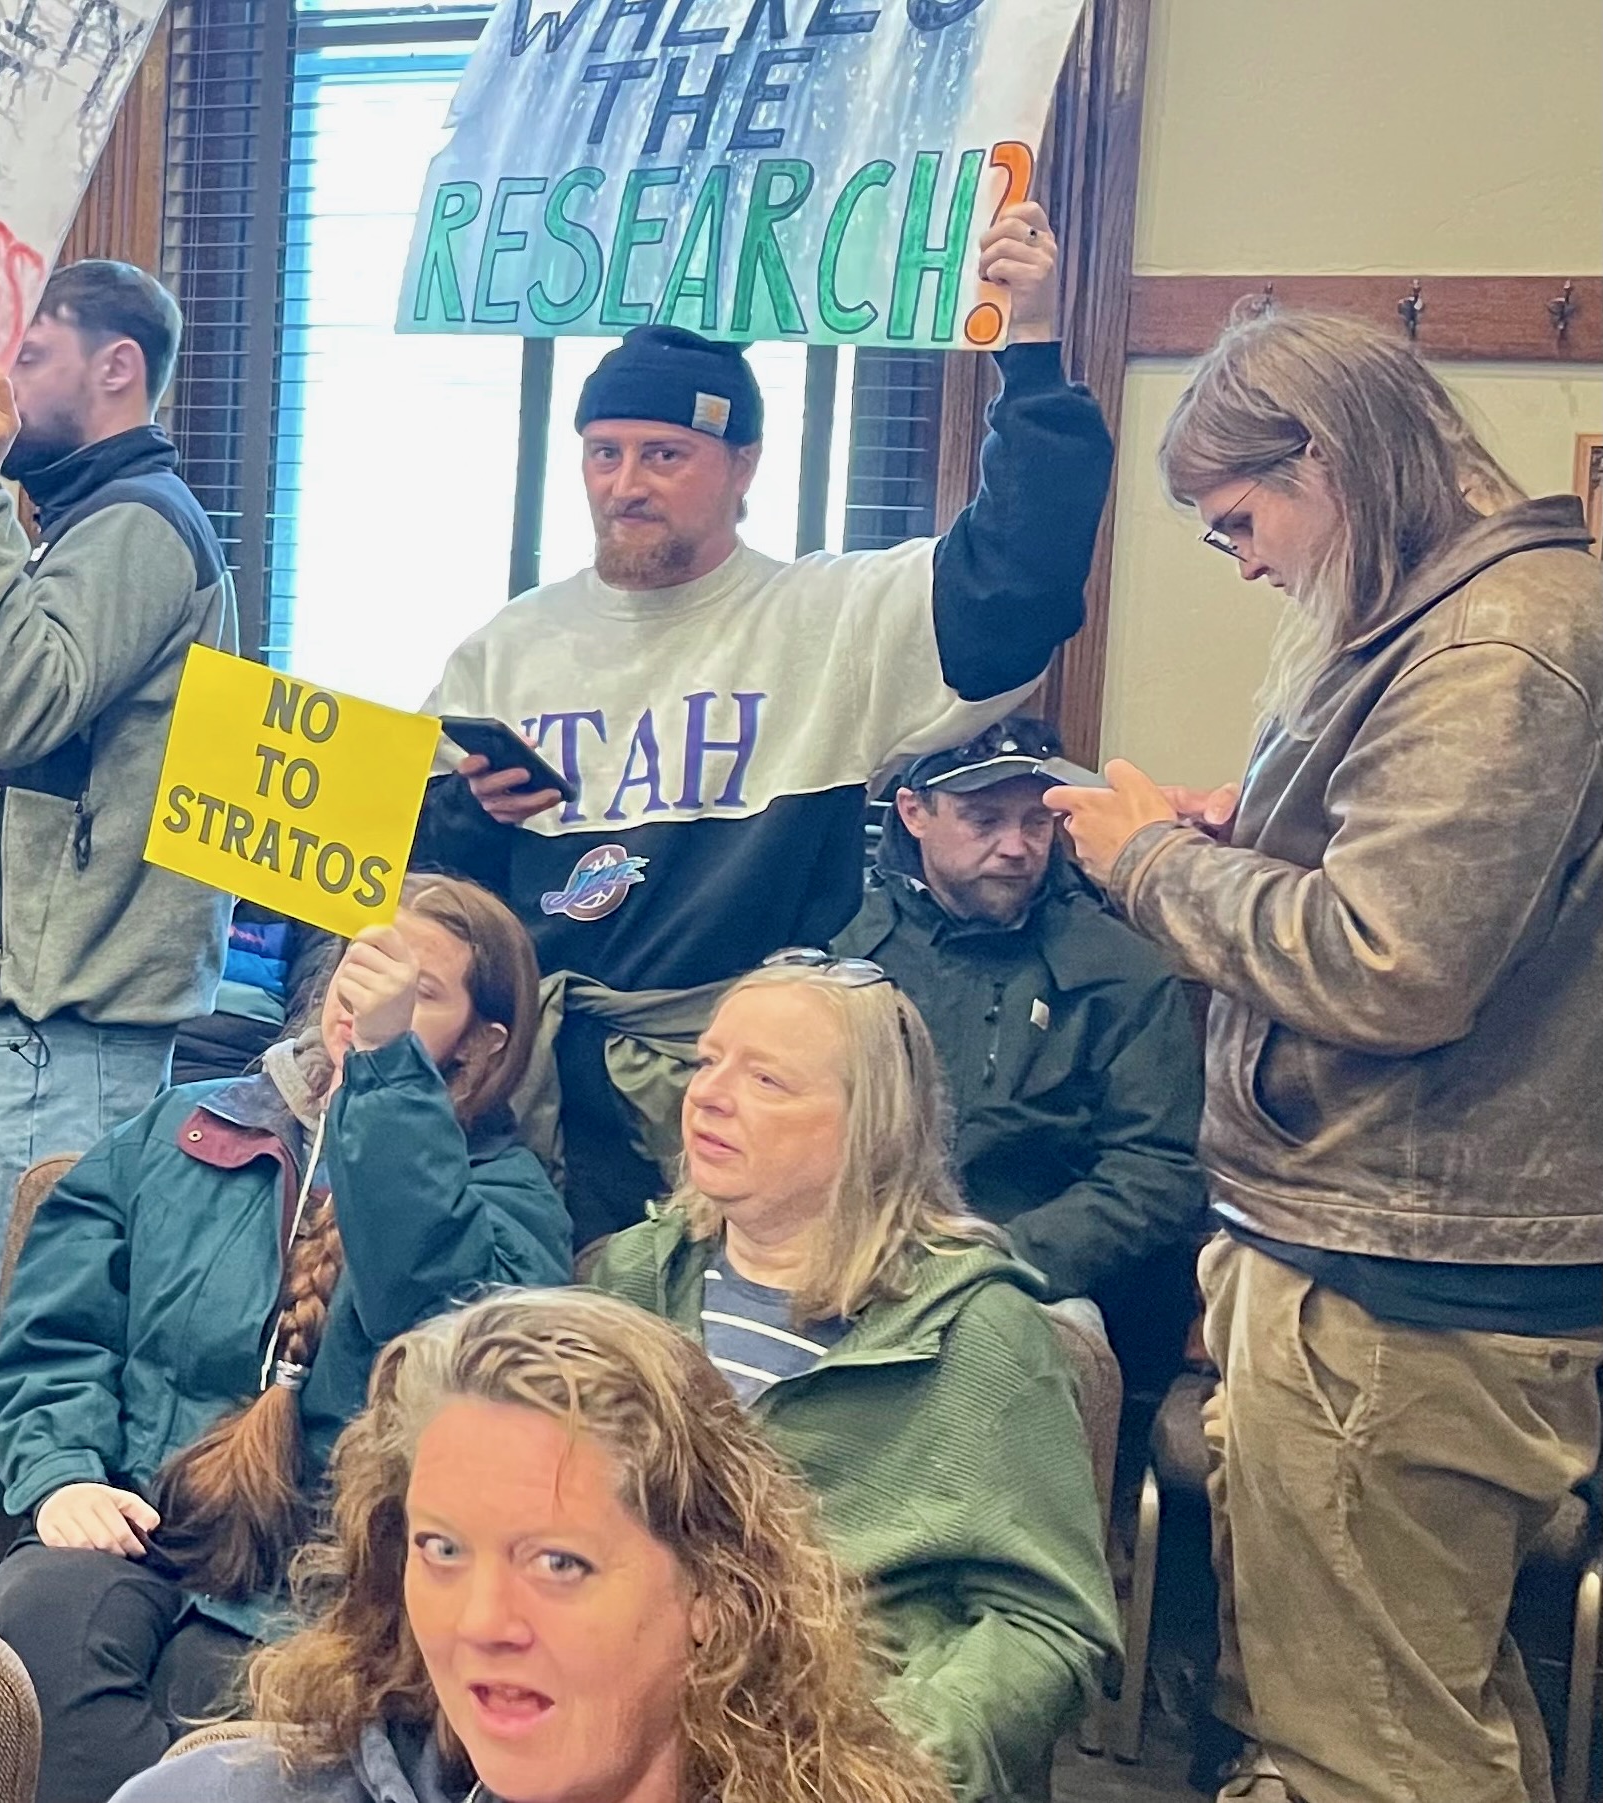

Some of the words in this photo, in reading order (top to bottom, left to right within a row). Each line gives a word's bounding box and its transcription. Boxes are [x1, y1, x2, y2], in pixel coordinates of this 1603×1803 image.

[582, 46, 815, 154] THE
[262, 677, 339, 743] NO
[520, 688, 768, 825] TAH
[255, 743, 320, 809] TO
[162, 784, 392, 908] STRATOS
